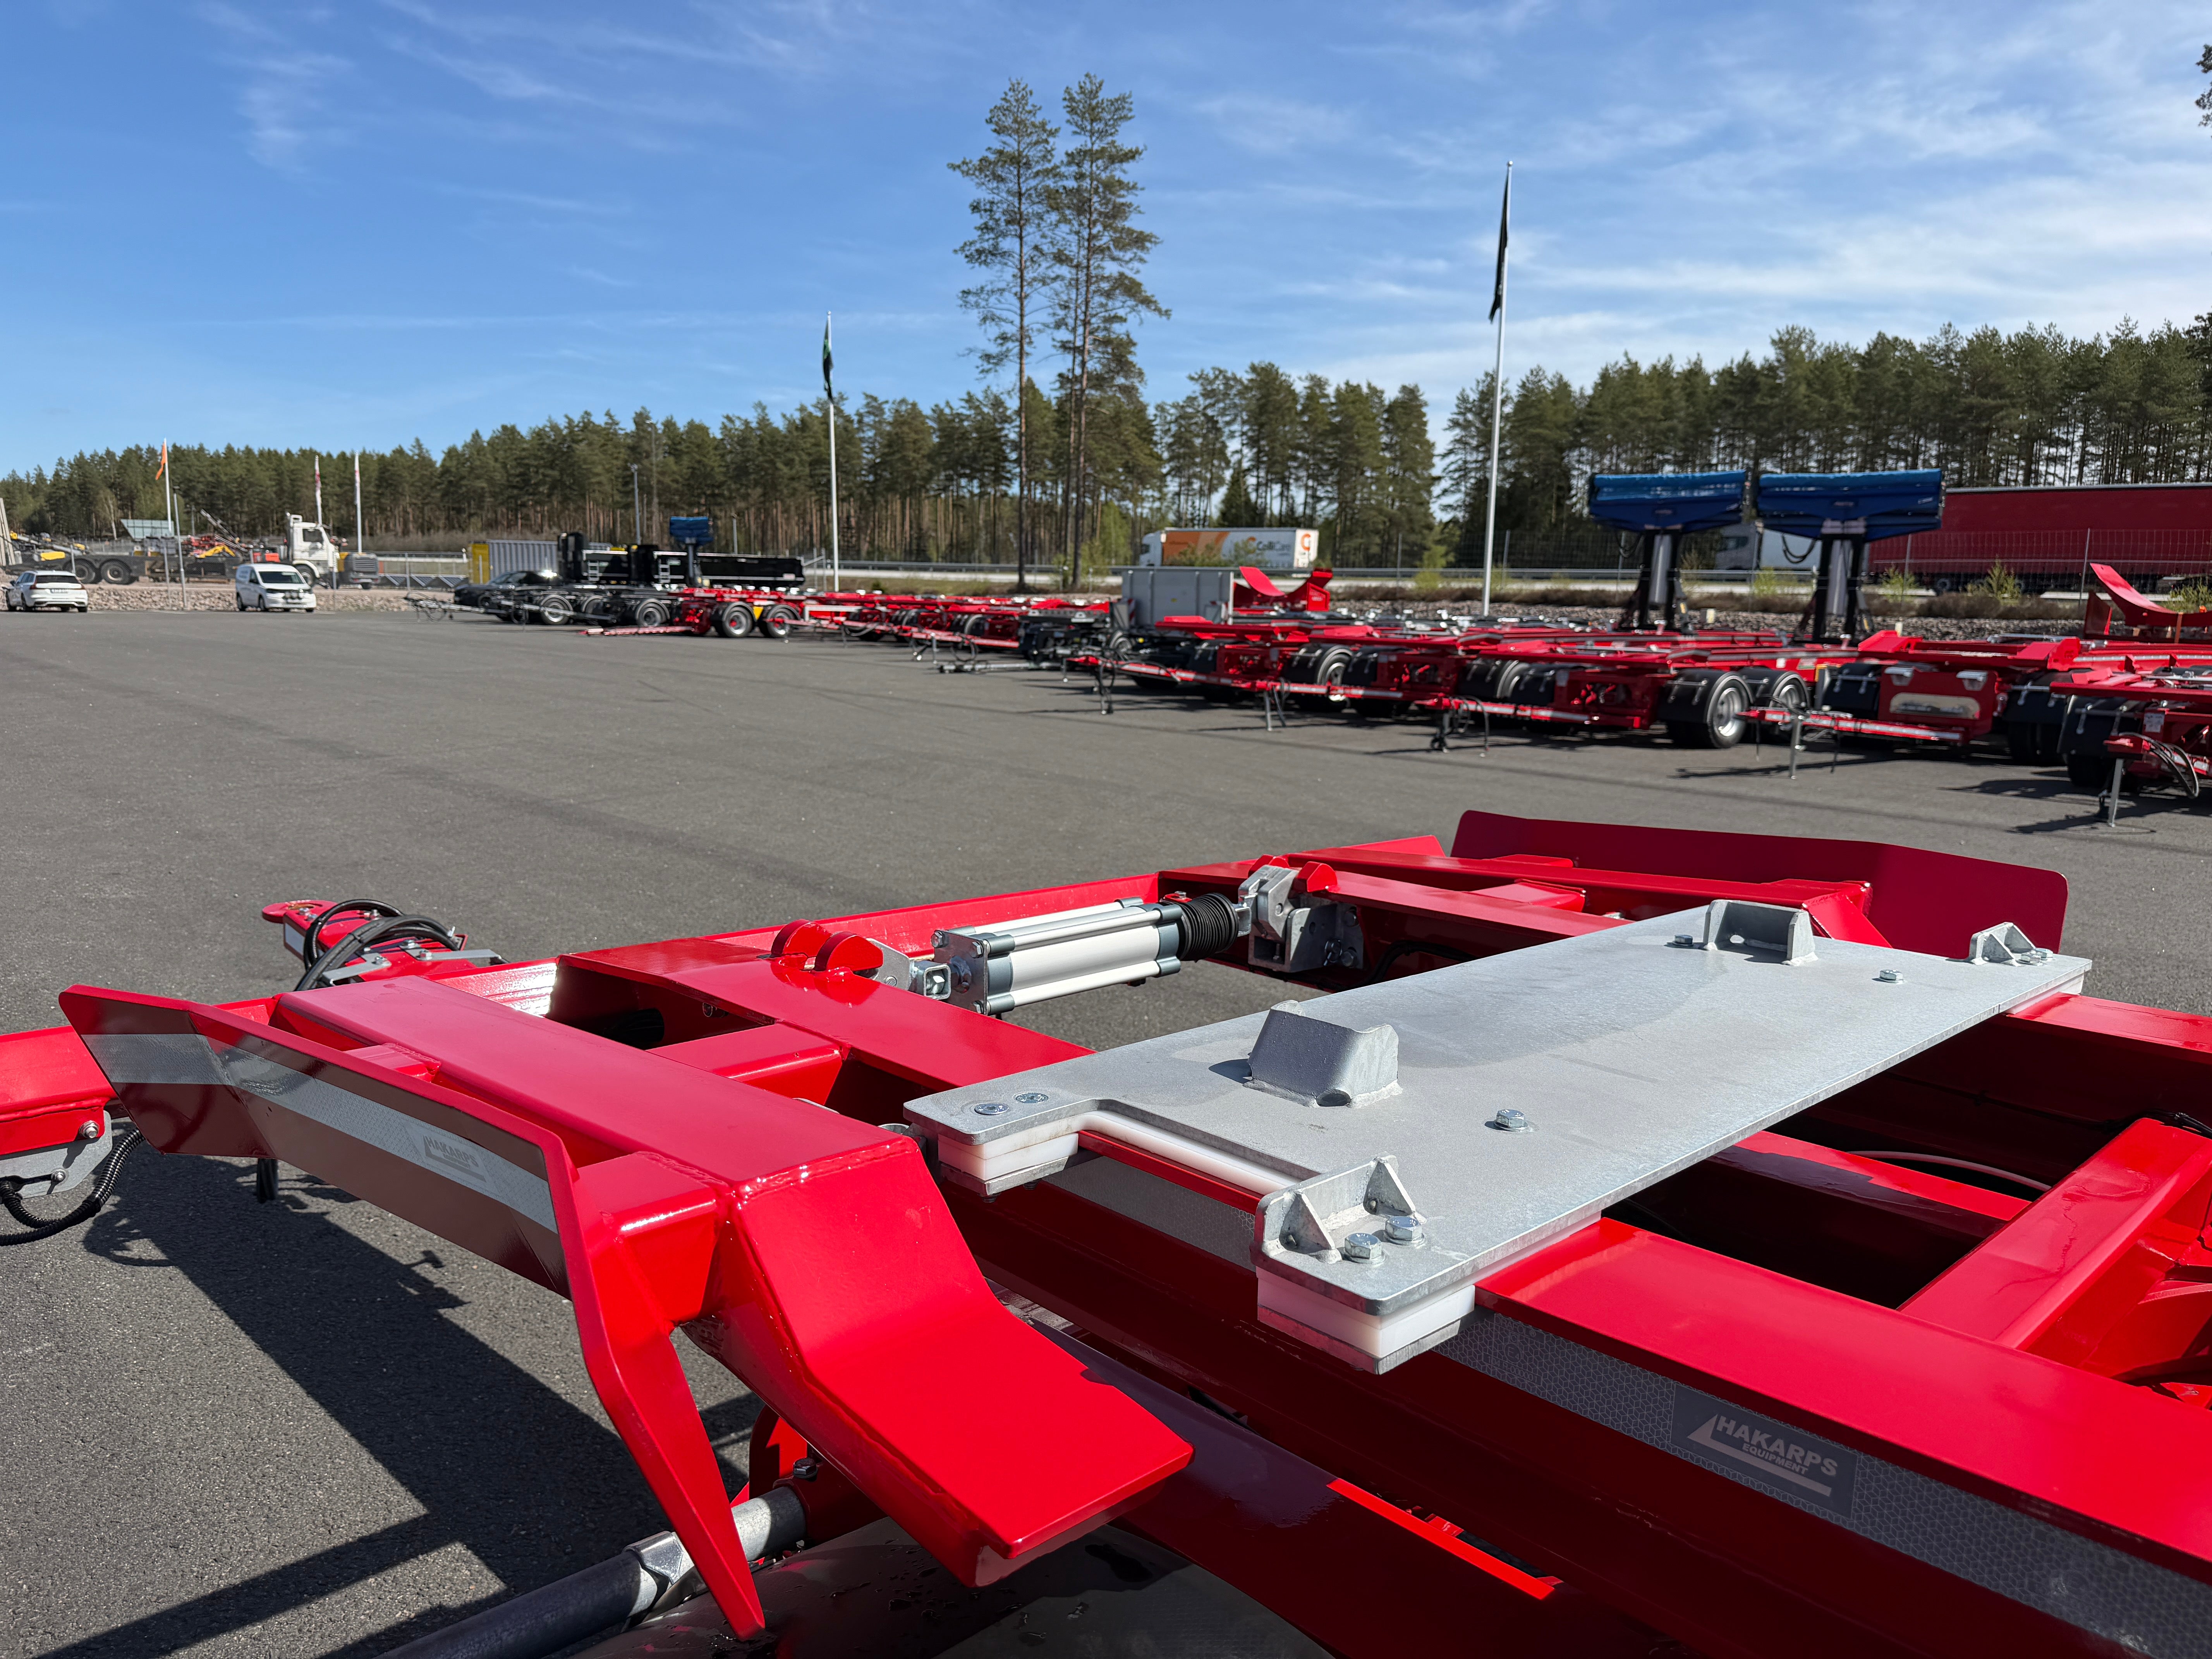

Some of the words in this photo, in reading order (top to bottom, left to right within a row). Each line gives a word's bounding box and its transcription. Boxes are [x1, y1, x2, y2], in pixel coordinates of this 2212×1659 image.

[426, 1135, 479, 1167] HAKARPS
[1717, 1416, 1838, 1476] HAKARPS
[1742, 1444, 1808, 1474] EQUIPMENT
